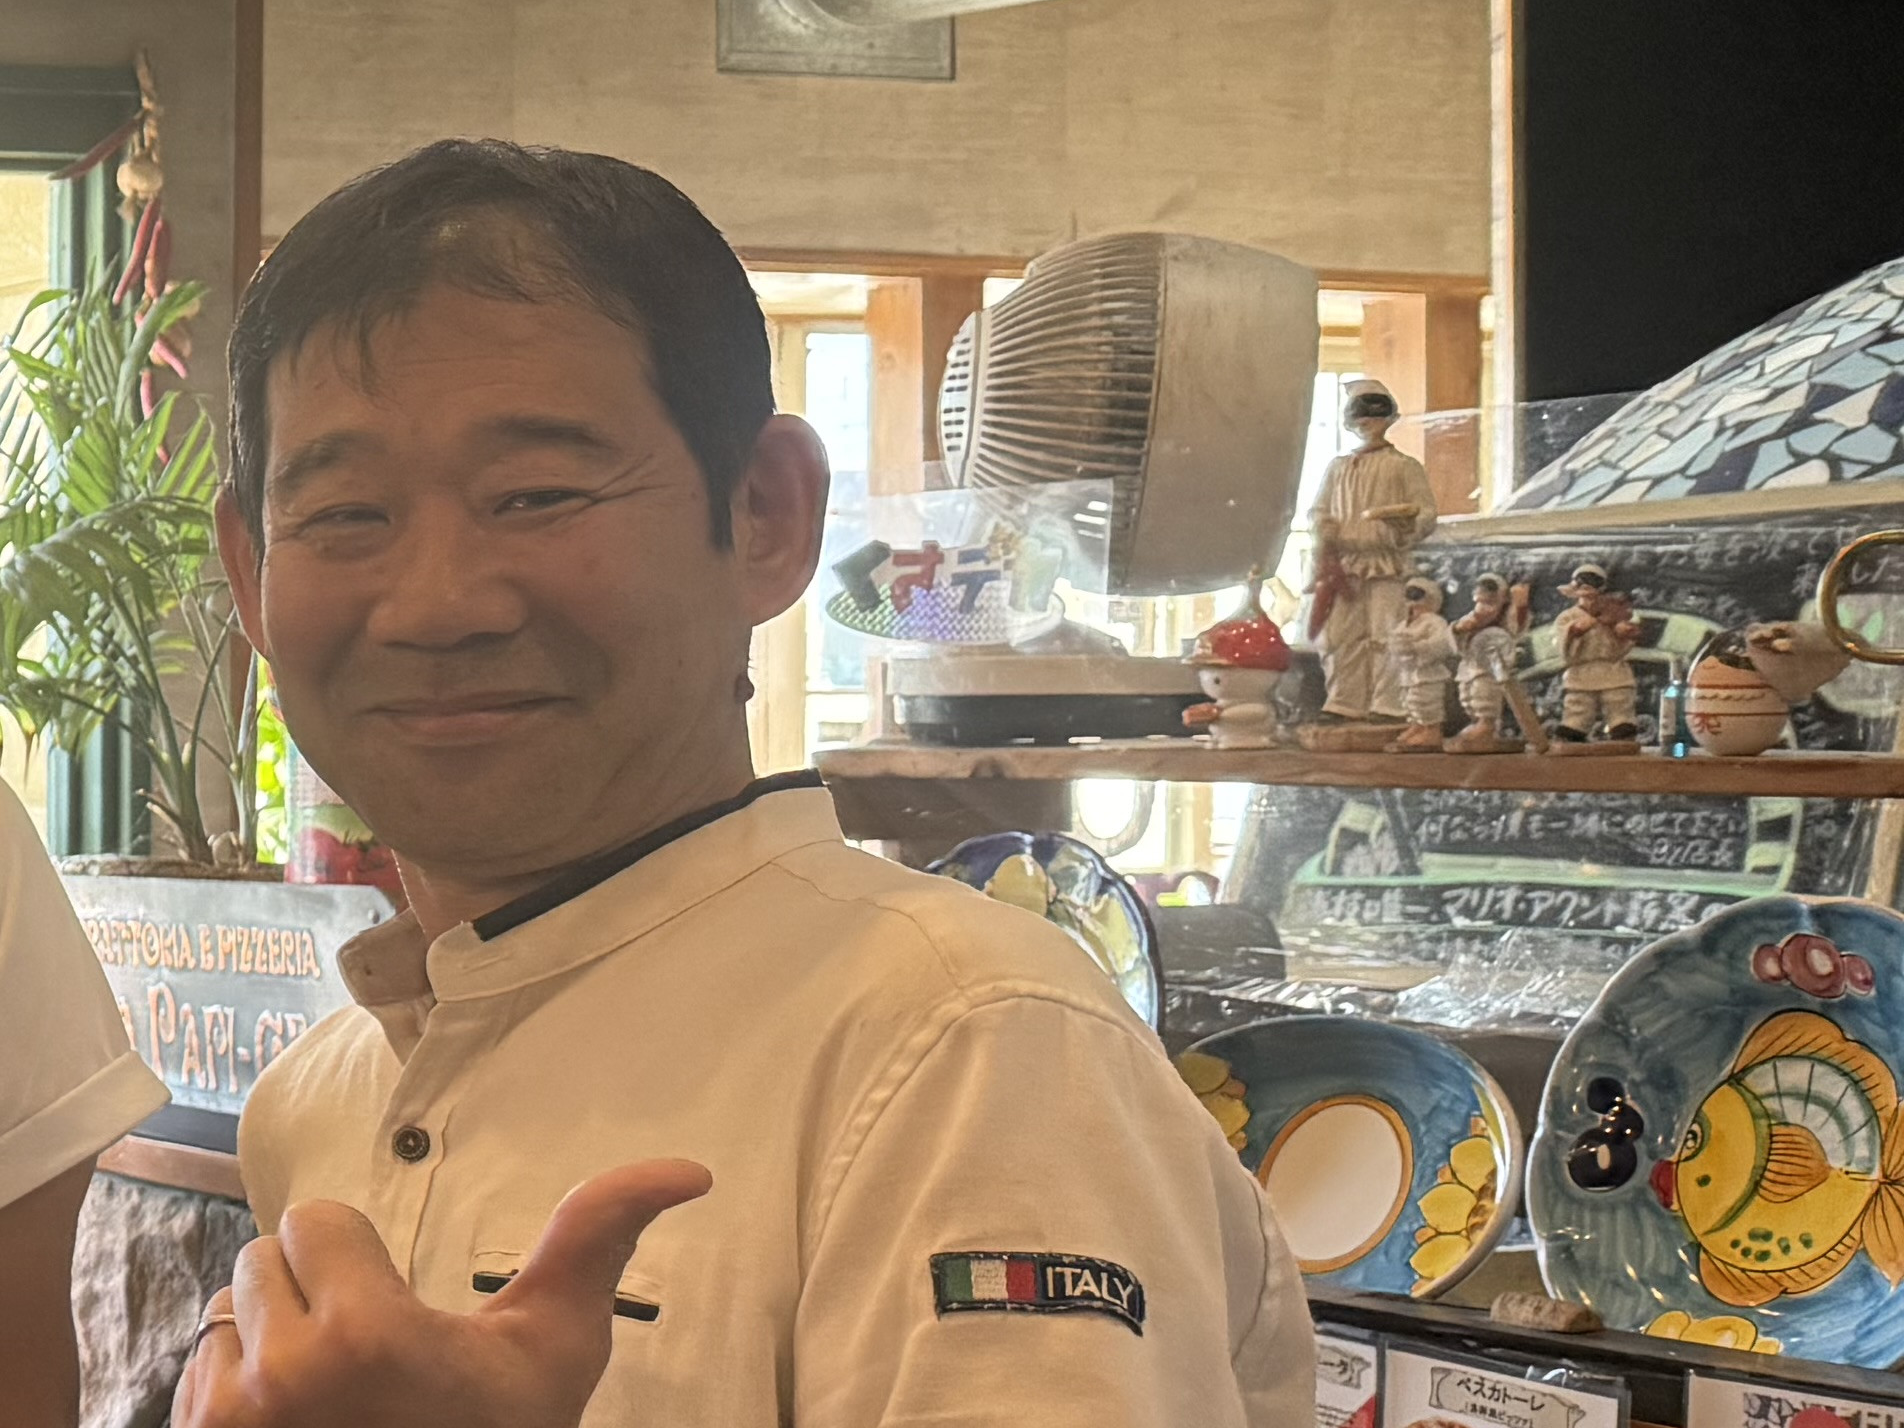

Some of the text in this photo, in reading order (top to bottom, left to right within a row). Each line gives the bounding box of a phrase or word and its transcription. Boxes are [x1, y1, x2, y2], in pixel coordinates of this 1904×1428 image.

[199, 923, 215, 971] E
[215, 924, 322, 978] PIZZERIA
[1046, 1266, 1134, 1310] ITALY
[1456, 1375, 1547, 1412] ペスカトーレ
